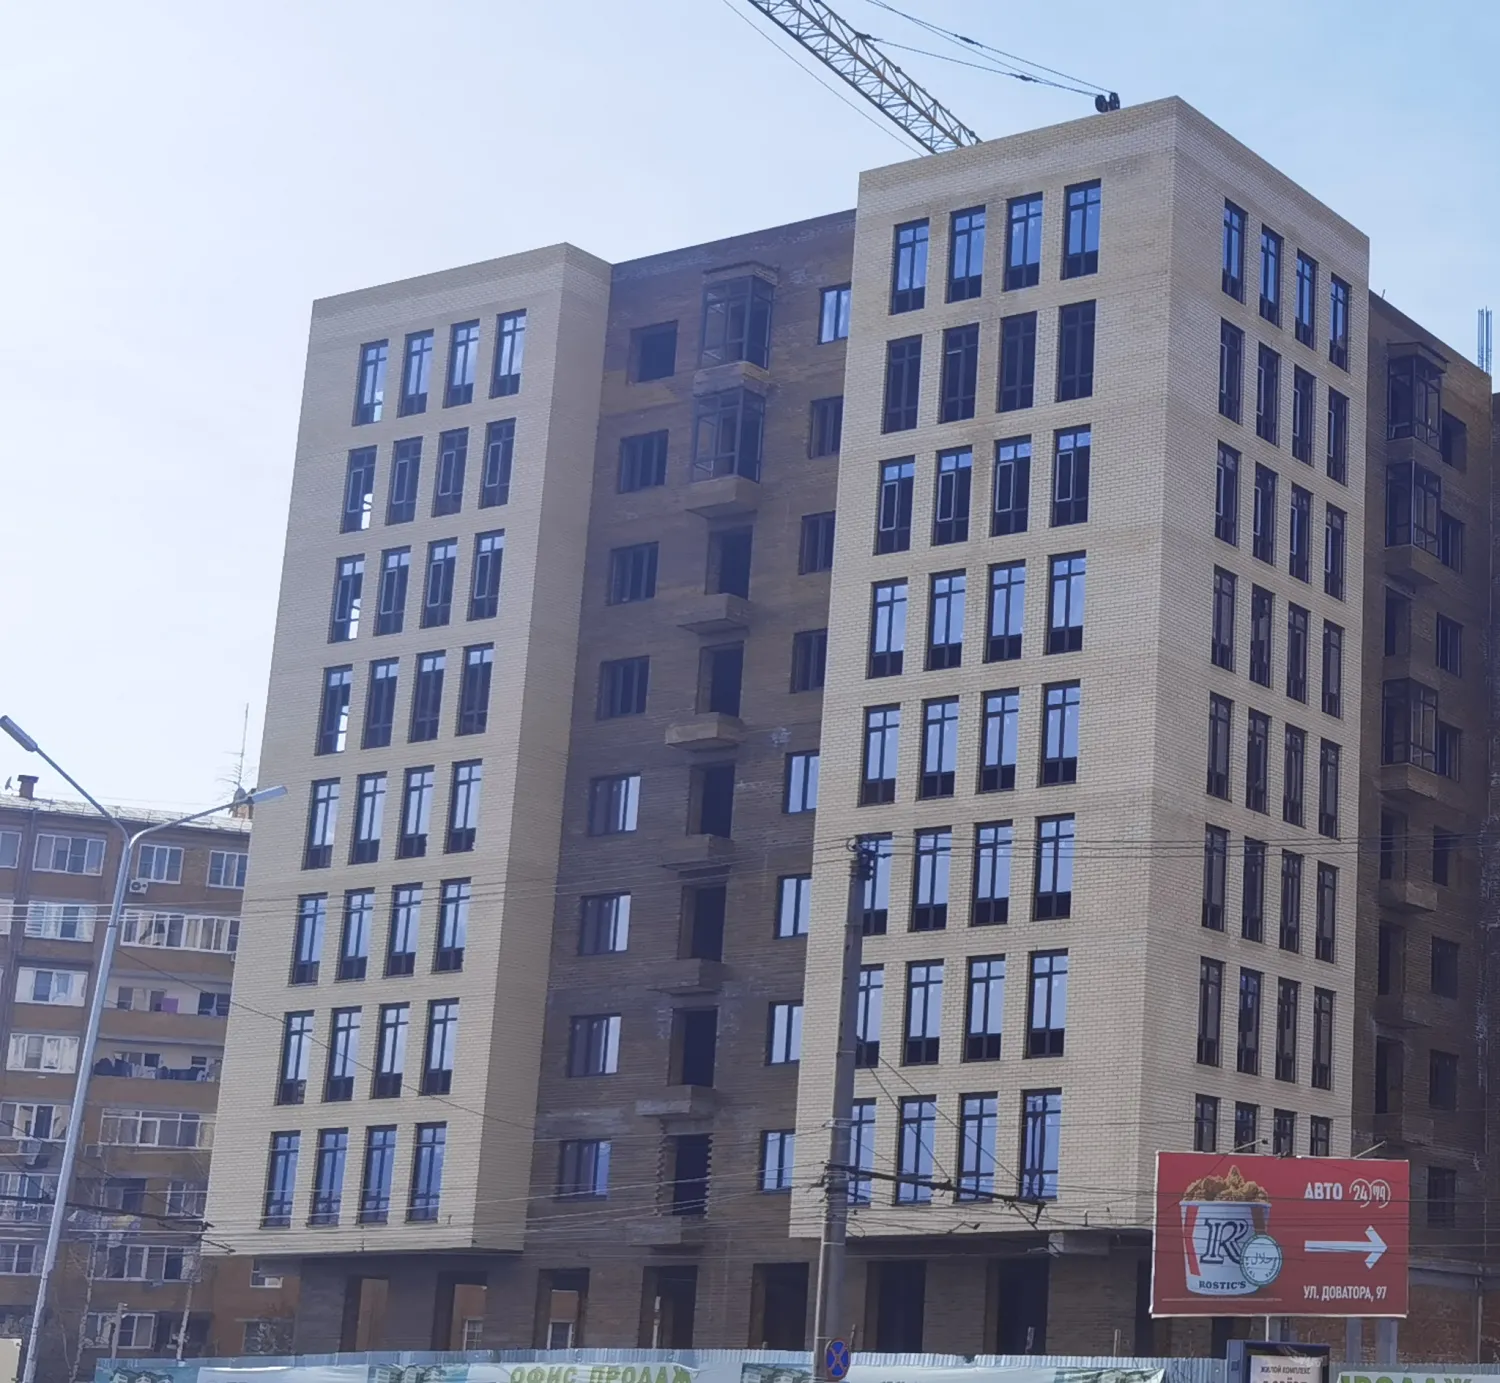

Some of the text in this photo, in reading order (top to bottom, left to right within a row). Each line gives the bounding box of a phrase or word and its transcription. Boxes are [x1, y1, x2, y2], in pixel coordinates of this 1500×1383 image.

[1304, 1182, 1343, 1200] АВТО
[1199, 1280, 1247, 1290] ROSTIC'S
[1303, 1285, 1387, 1302] УЛ. ДОВАТОРА, 97
[510, 1366, 577, 1383] ОФИС
